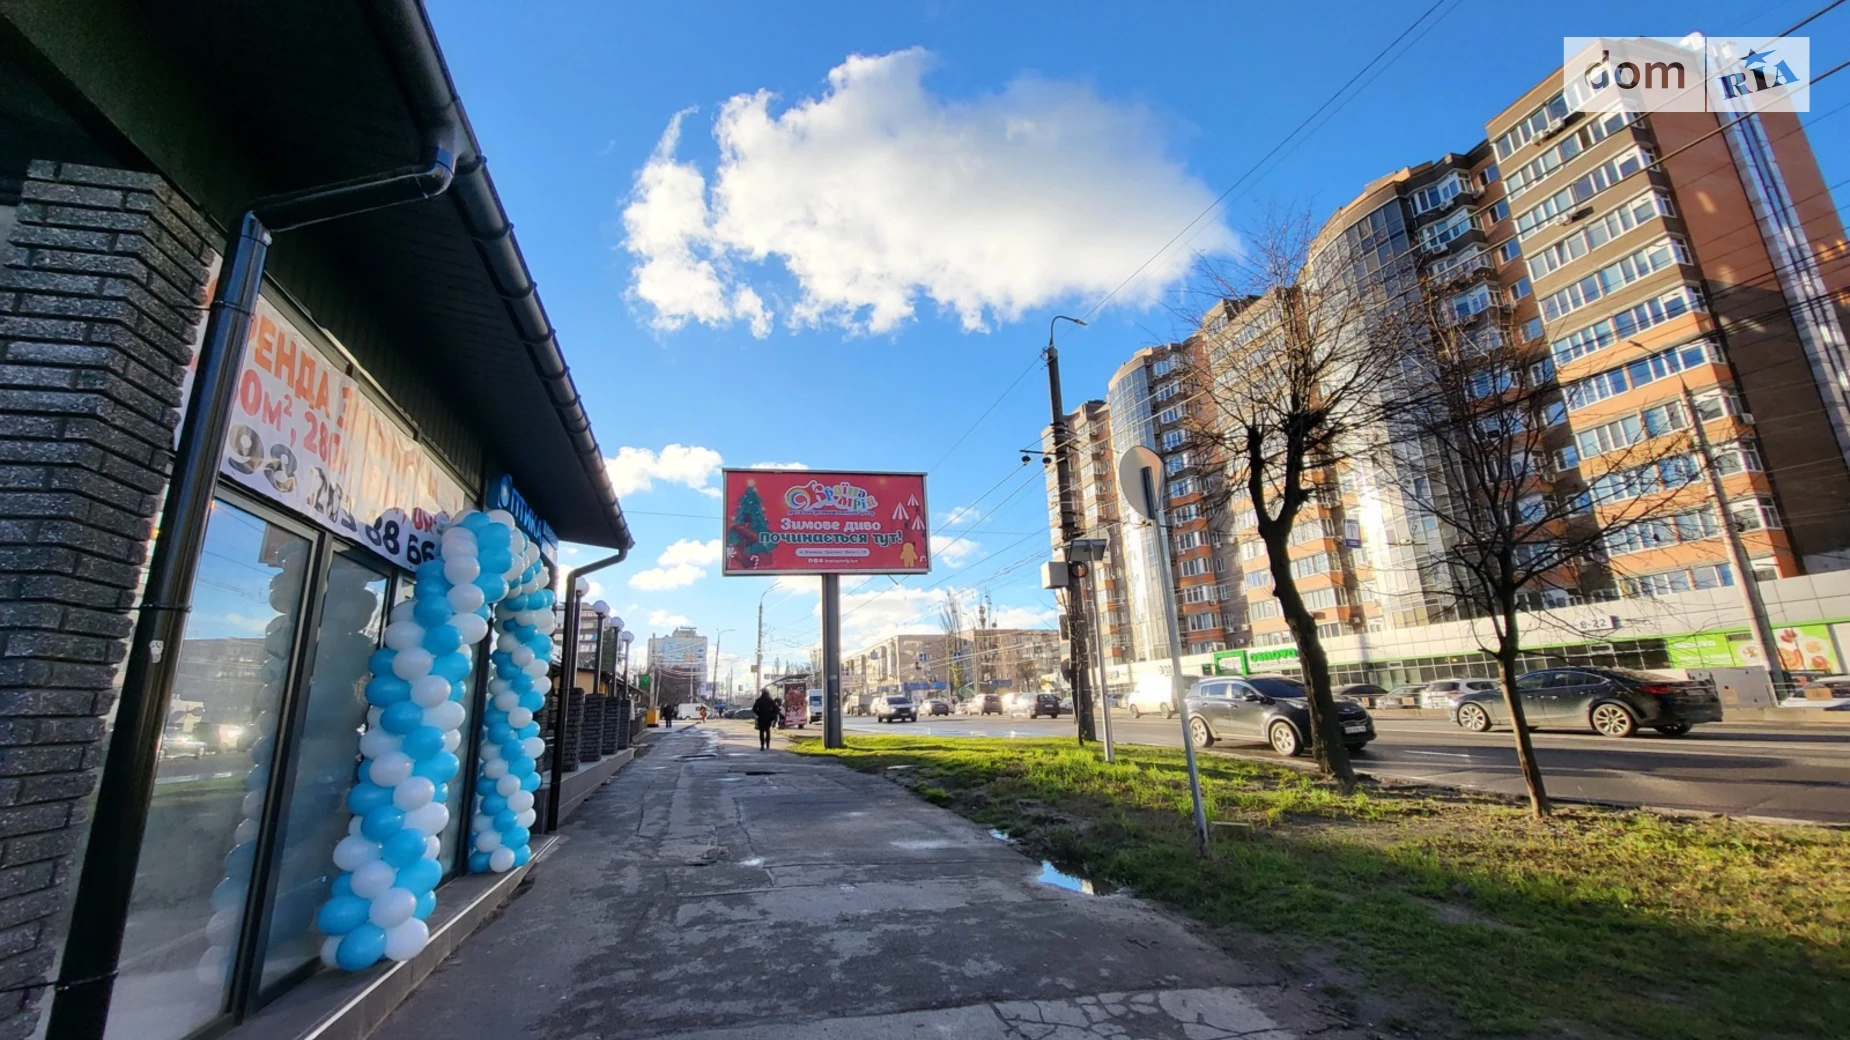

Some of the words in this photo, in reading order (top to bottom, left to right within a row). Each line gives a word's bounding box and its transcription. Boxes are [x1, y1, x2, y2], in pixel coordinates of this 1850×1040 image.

[780, 518, 840, 531] Зимове
[843, 520, 881, 532] диво
[759, 532, 868, 544] починається
[872, 530, 903, 547] тут!
